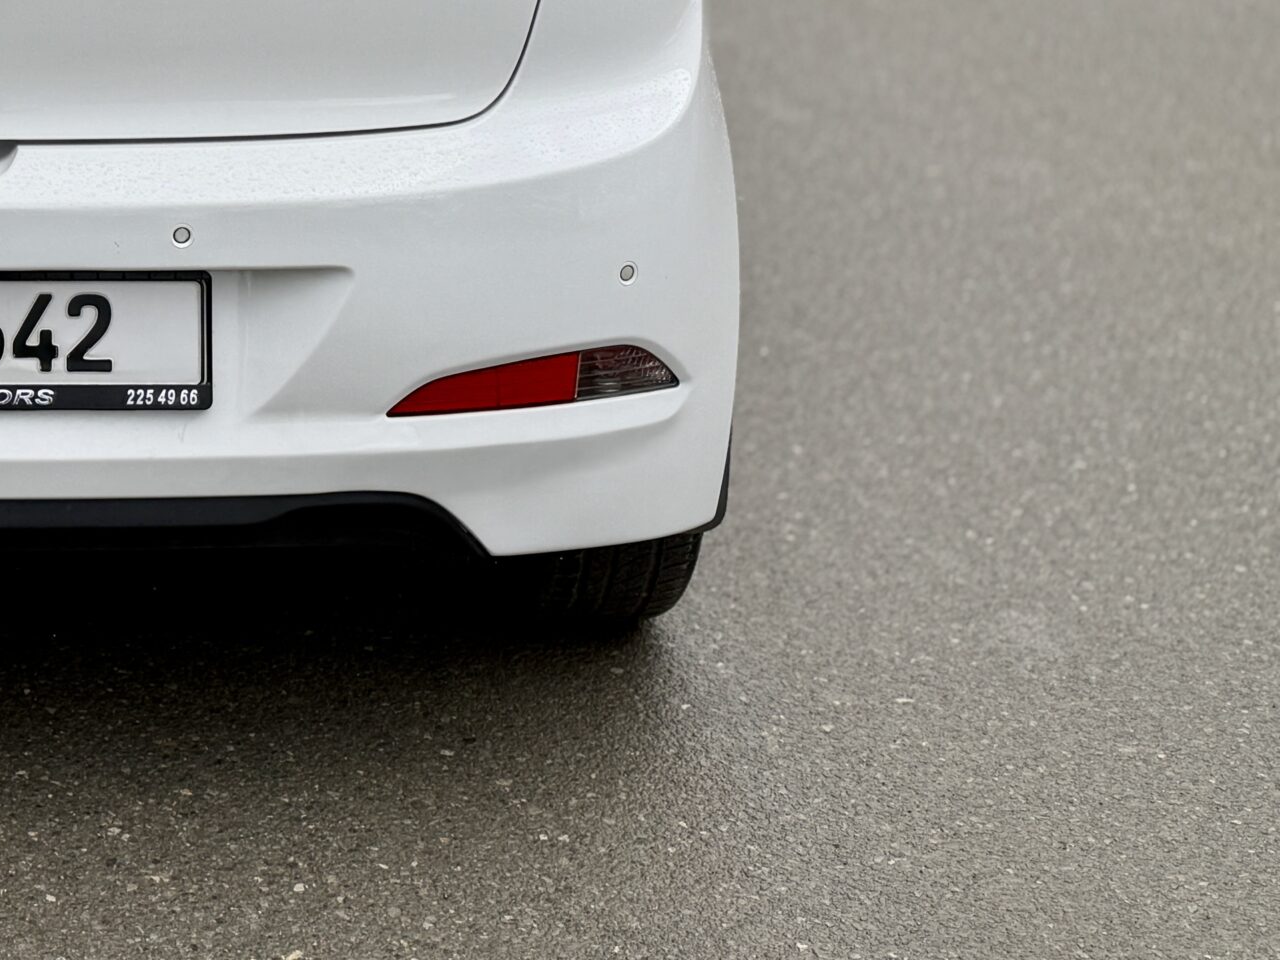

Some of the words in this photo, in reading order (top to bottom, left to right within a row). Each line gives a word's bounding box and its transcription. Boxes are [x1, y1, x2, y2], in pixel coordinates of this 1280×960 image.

[126, 388, 154, 405] 225
[157, 388, 176, 405] 49
[180, 388, 199, 405] 66
